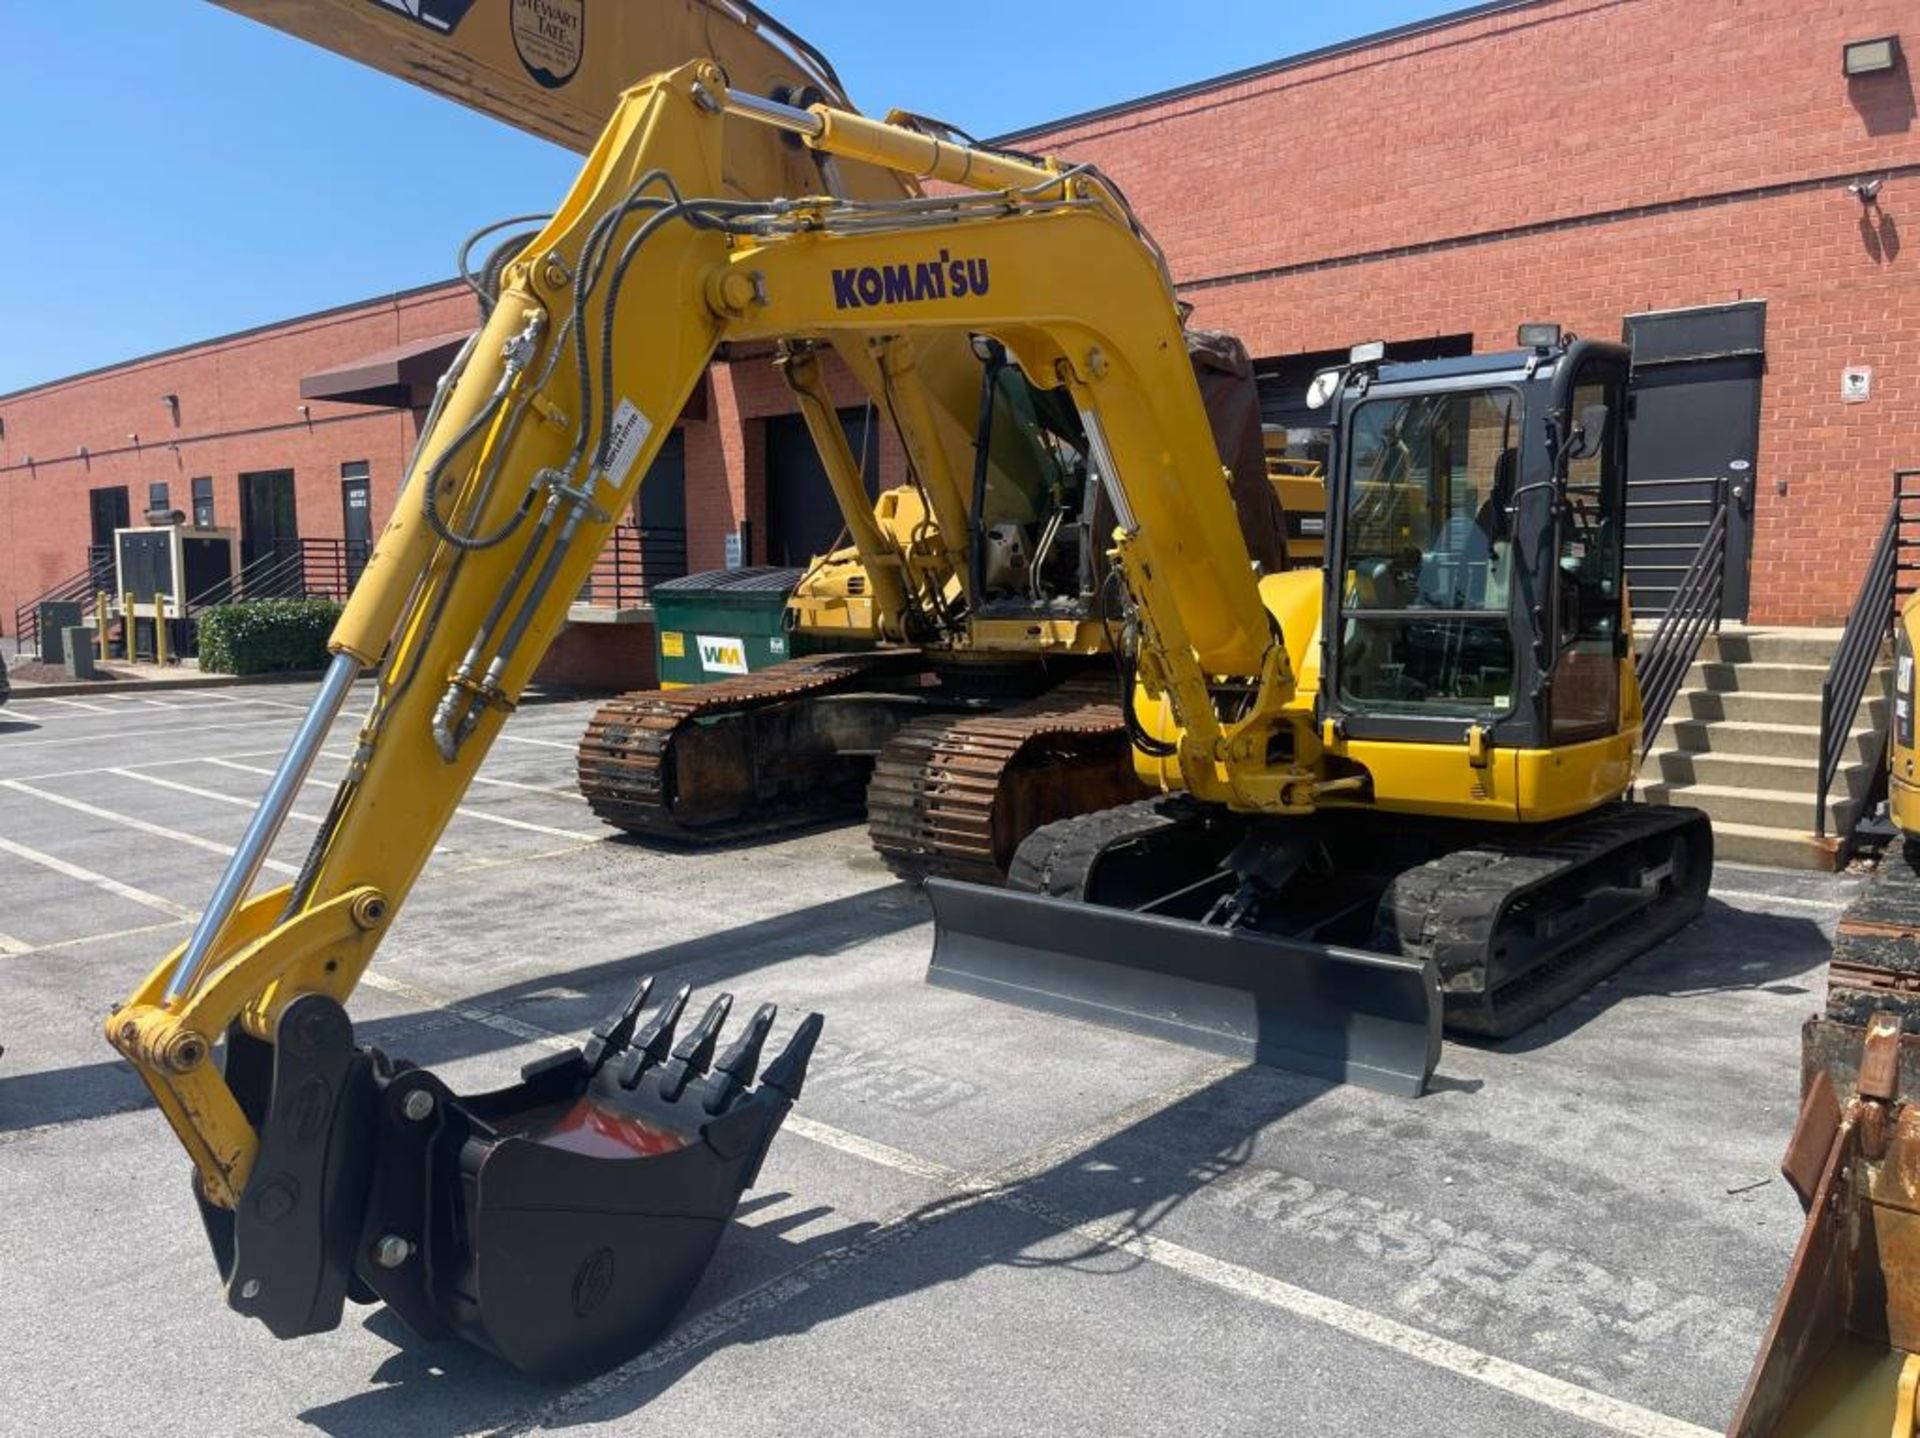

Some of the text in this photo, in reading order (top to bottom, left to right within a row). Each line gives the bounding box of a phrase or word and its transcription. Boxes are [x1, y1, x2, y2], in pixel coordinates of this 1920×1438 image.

[537, 14, 567, 42] TATE
[832, 249, 989, 309] KOMATSU
[704, 646, 740, 665] WM
